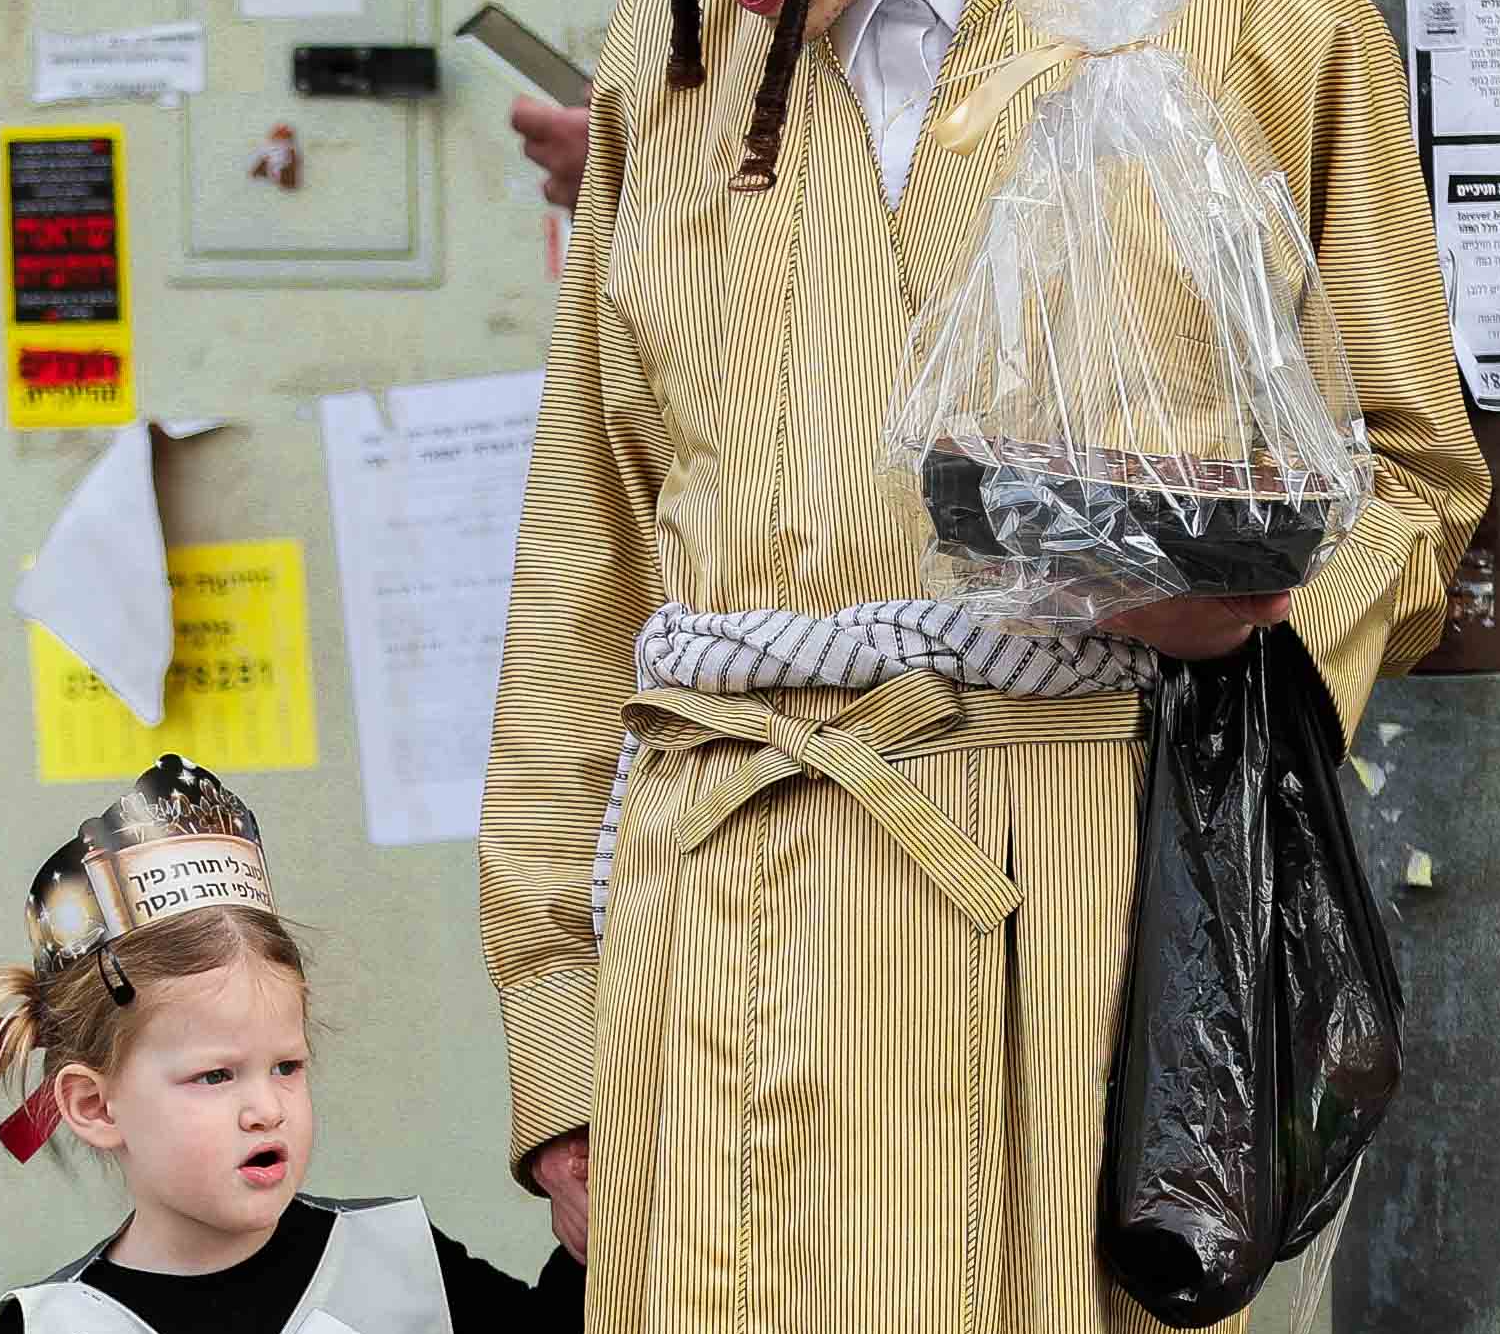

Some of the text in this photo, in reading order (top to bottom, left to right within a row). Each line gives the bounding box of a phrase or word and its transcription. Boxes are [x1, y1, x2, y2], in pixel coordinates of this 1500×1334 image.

[170, 858, 223, 879] תורת
[225, 856, 239, 874] לי
[129, 868, 166, 893] פיך
[195, 882, 229, 899] זהב
[136, 888, 189, 917] וכסף
